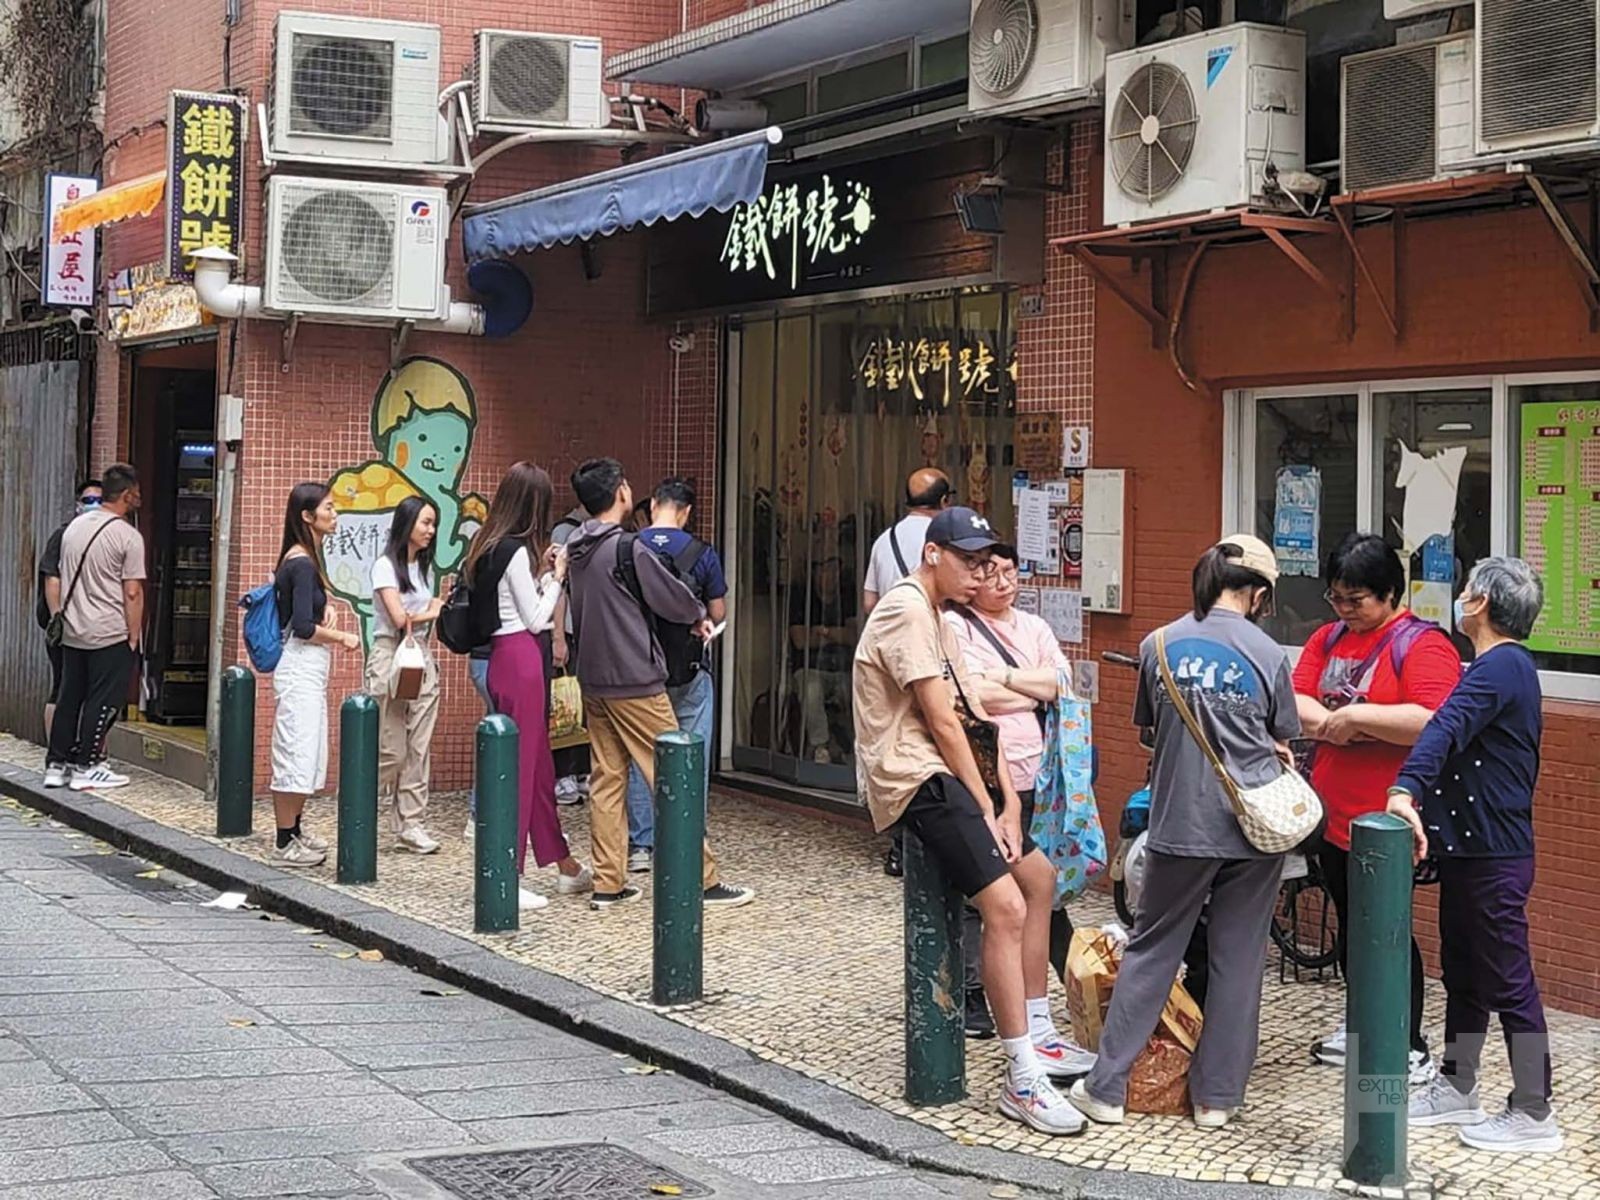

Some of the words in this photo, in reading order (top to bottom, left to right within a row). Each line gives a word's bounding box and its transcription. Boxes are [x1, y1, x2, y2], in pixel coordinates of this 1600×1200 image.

[721, 175, 847, 289] 鐵餅號
[859, 336, 999, 407] 鐵餅號
[325, 522, 391, 561] 鐵餅
